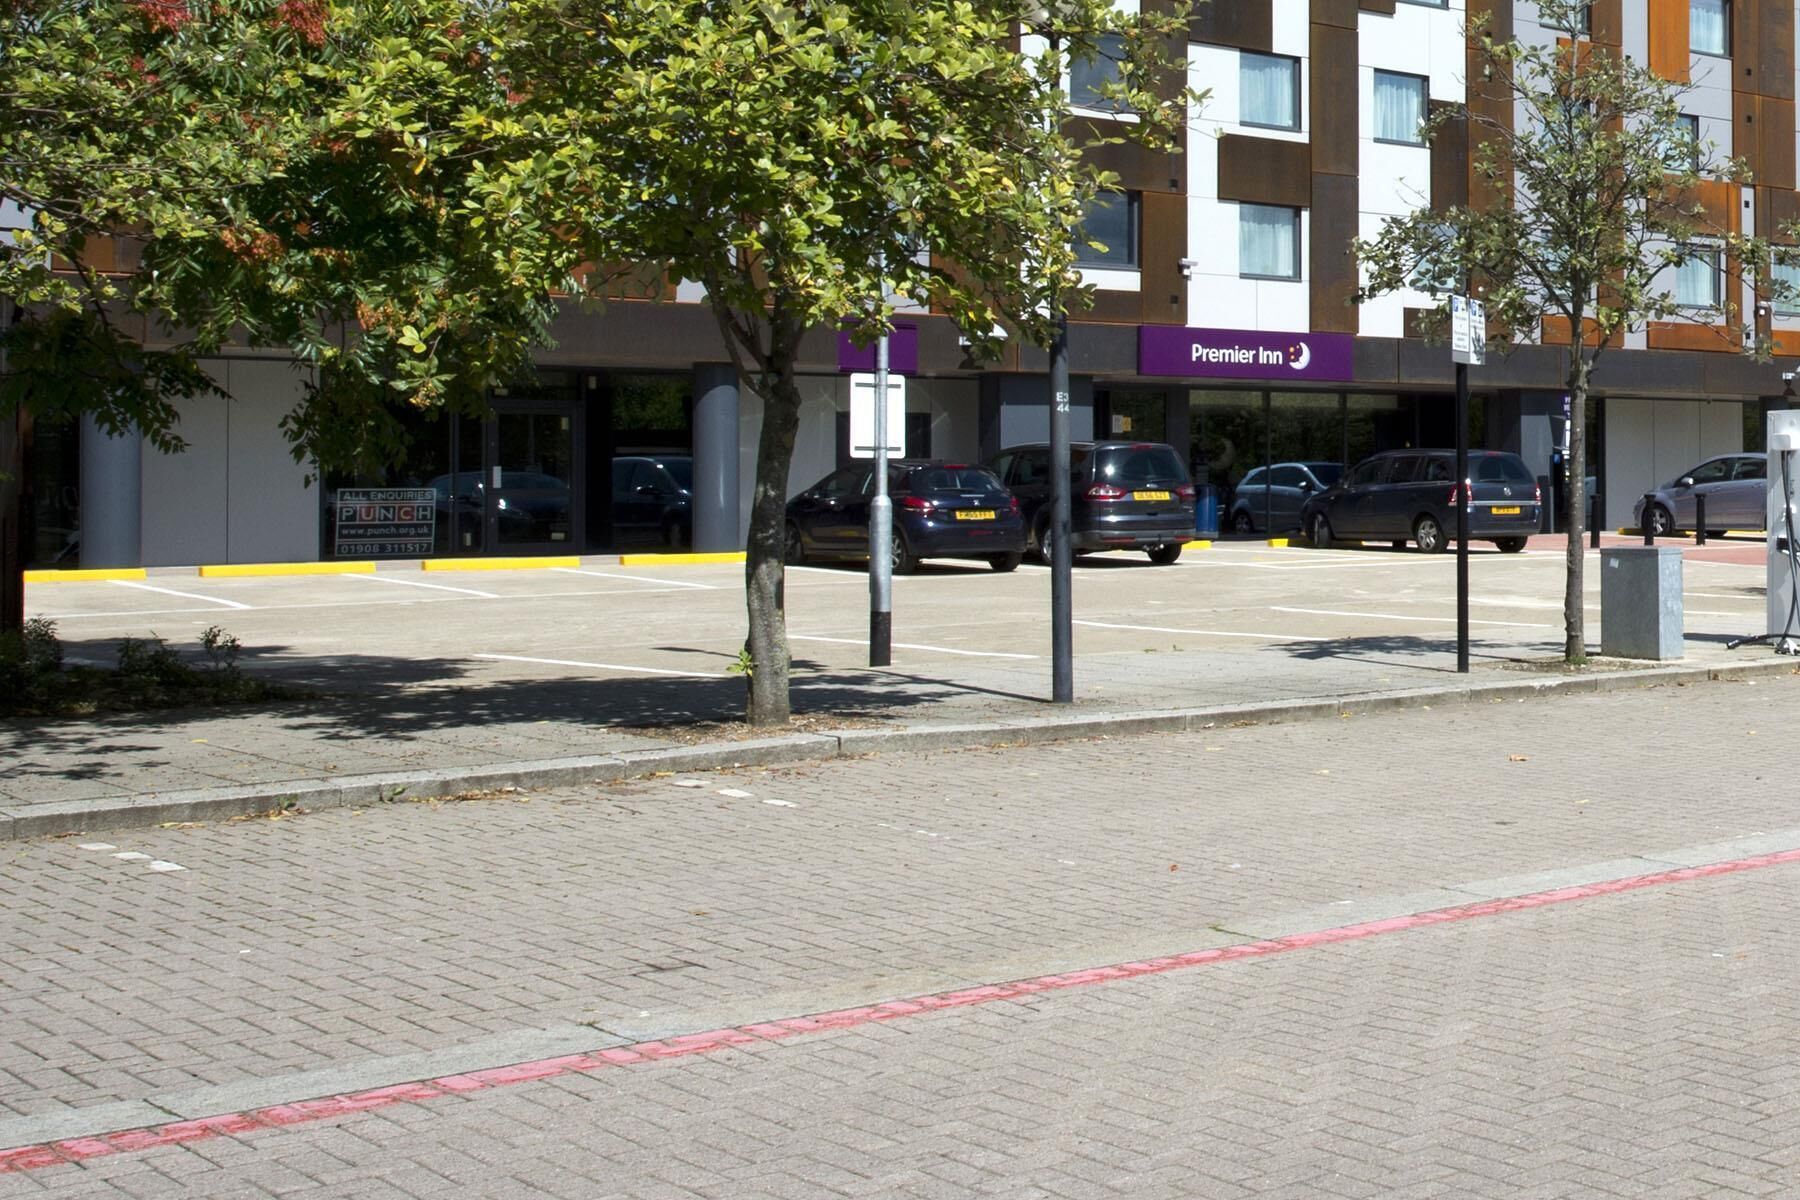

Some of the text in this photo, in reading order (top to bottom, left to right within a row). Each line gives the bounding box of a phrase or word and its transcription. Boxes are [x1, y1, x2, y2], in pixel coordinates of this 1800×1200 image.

[1191, 344, 1283, 365] Premier Inn
[343, 490, 432, 500] ALL ENQUIRIES
[342, 506, 431, 520] PUNCH
[341, 525, 430, 536] www.punch.org.uk
[341, 543, 428, 553] 01908 311517
